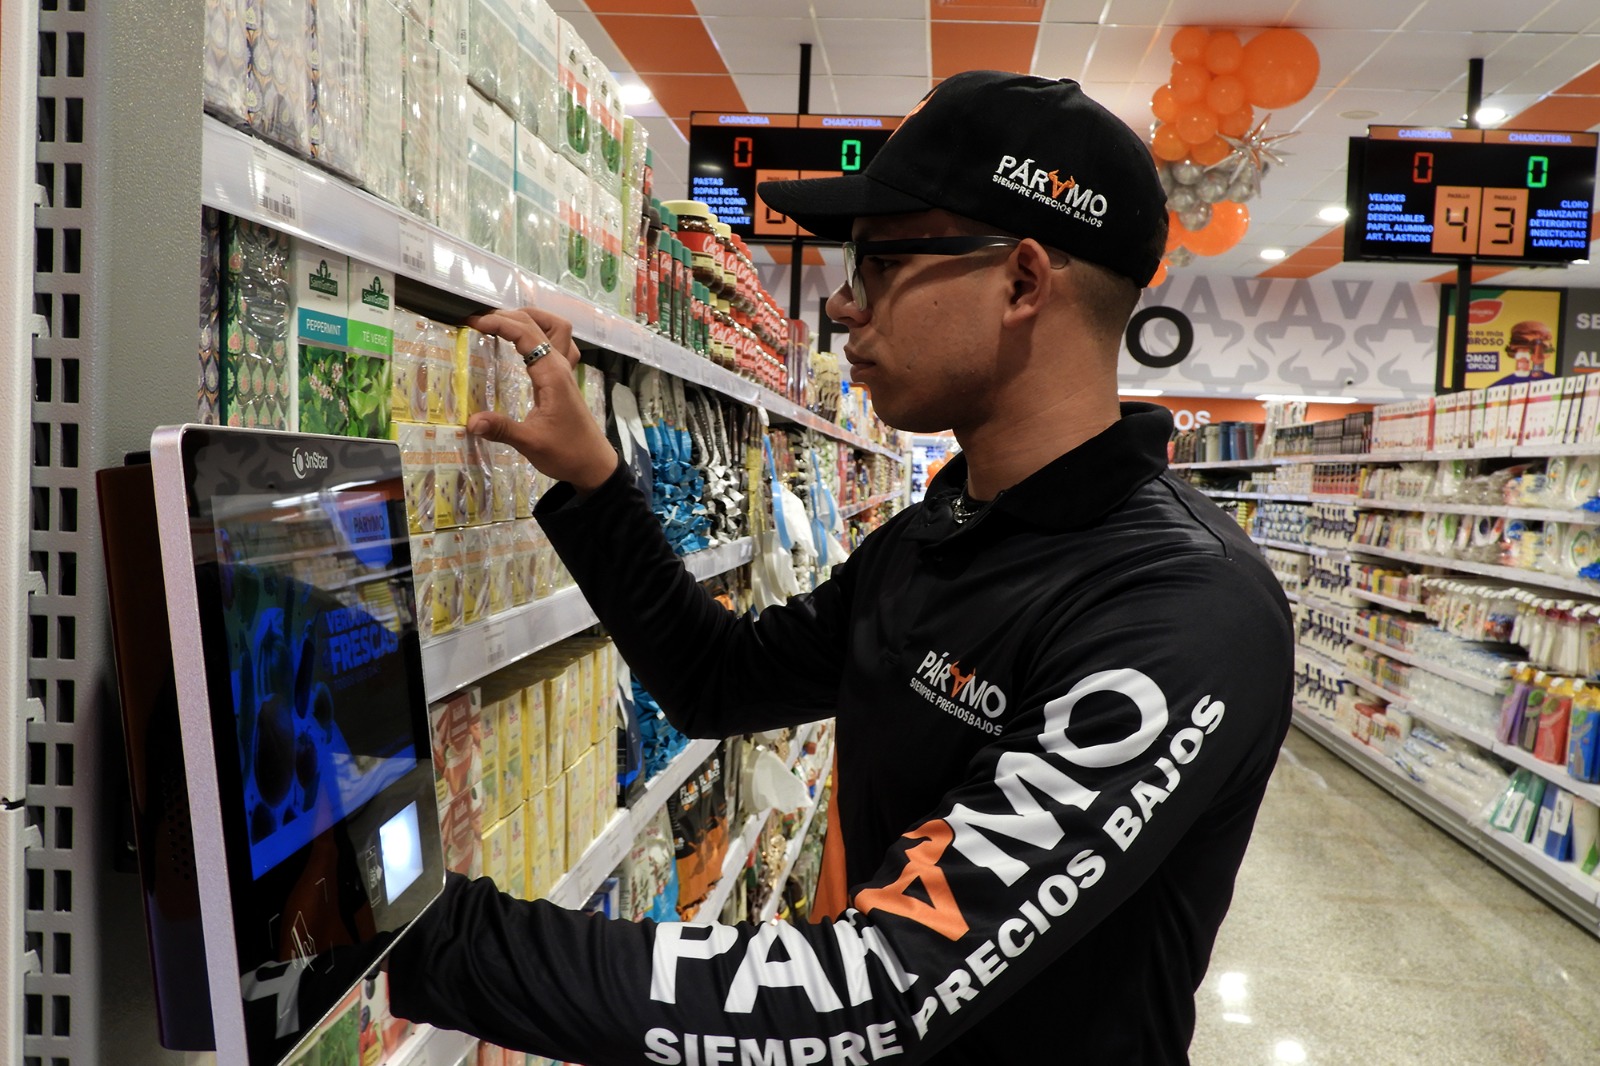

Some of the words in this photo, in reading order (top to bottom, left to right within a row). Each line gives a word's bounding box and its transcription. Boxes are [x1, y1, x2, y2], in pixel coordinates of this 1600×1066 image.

[733, 137, 753, 168] 0
[841, 139, 861, 171] 0
[1413, 152, 1434, 184] 0
[1526, 155, 1549, 188] 0
[693, 177, 724, 186] PASTAS
[693, 187, 719, 195] SOPAS
[1368, 193, 1406, 203] VELONES
[992, 174, 1032, 198] SIEMPRE
[1032, 191, 1072, 215] PRECIOS
[1073, 210, 1103, 228] BAJOS
[1560, 200, 1589, 209] CLORO
[1367, 213, 1425, 223] DESECHABLES
[1537, 209, 1588, 219] SUAVIZANTE
[1366, 223, 1392, 232] PAPEL
[1393, 224, 1434, 233] ALUMINIO
[1446, 206, 1469, 243] 4
[1491, 207, 1515, 245] 3
[1529, 219, 1587, 229] DETERGENTES
[1530, 229, 1587, 239] INSECTICIDAS
[1532, 239, 1586, 249] LAVAPLATOS
[306, 318, 341, 336] PEPPERMINT
[370, 332, 388, 347] VERDE
[1467, 337, 1504, 346] BROSO
[1172, 409, 1211, 431] OS
[304, 452, 328, 469] 3nStar
[909, 677, 937, 703] SIEMPRE
[644, 1020, 904, 1066] SIEMPRE
[911, 848, 1106, 1041] PRECIOS
[1102, 693, 1225, 853] BAJOS
